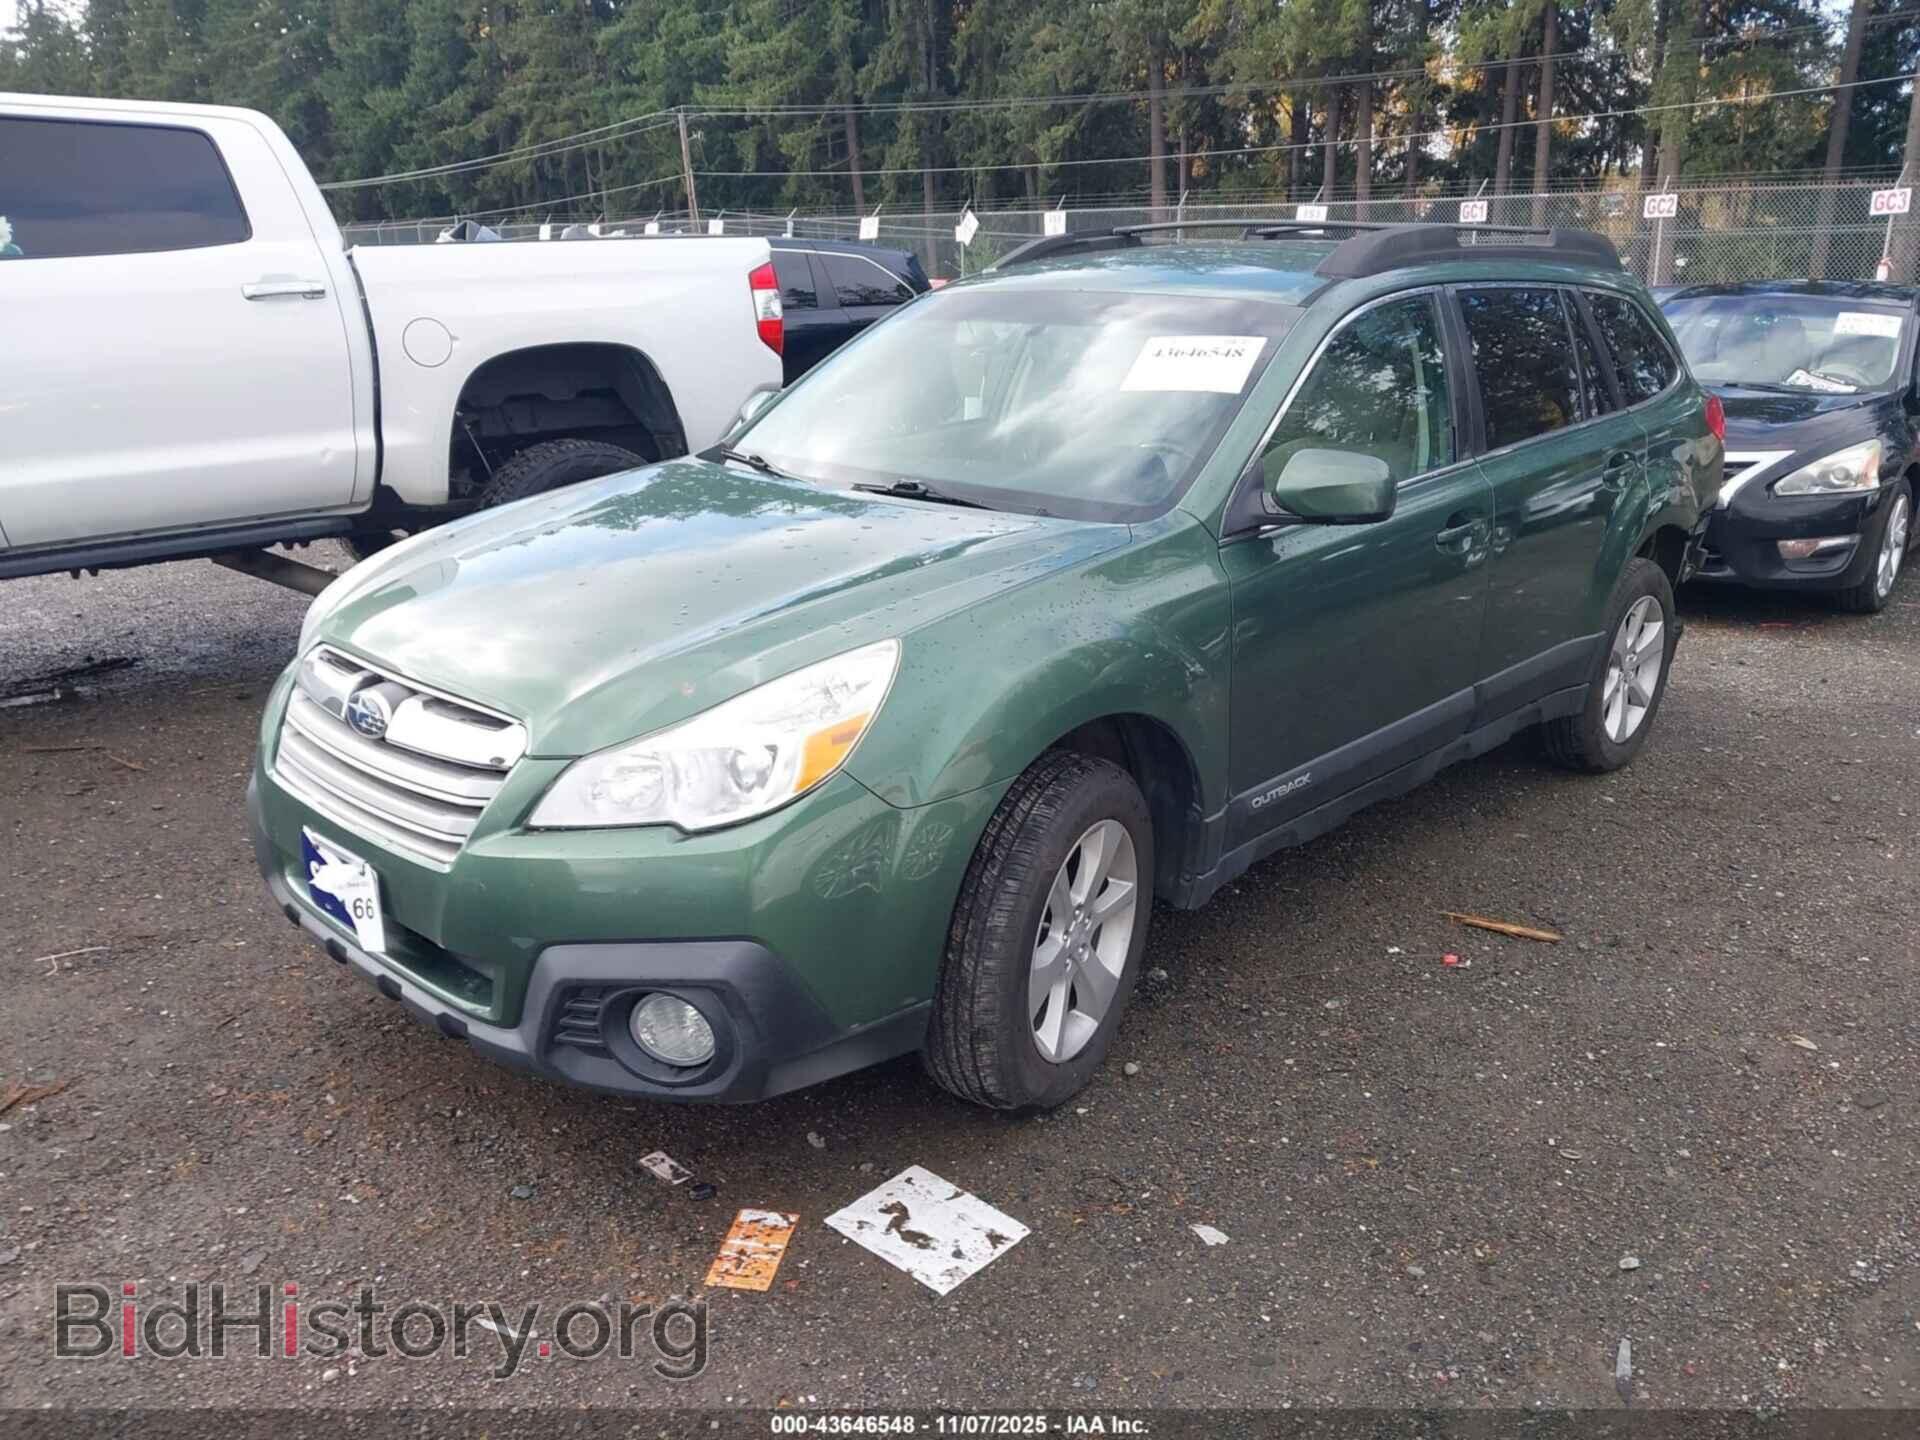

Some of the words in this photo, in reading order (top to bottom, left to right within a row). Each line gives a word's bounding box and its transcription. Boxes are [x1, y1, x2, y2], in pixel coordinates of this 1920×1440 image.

[1462, 203, 1484, 219] GC1
[1647, 198, 1675, 214] GC2
[1874, 192, 1907, 211] GC3
[1251, 772, 1312, 808] OUTBACK
[352, 897, 374, 920] 66
